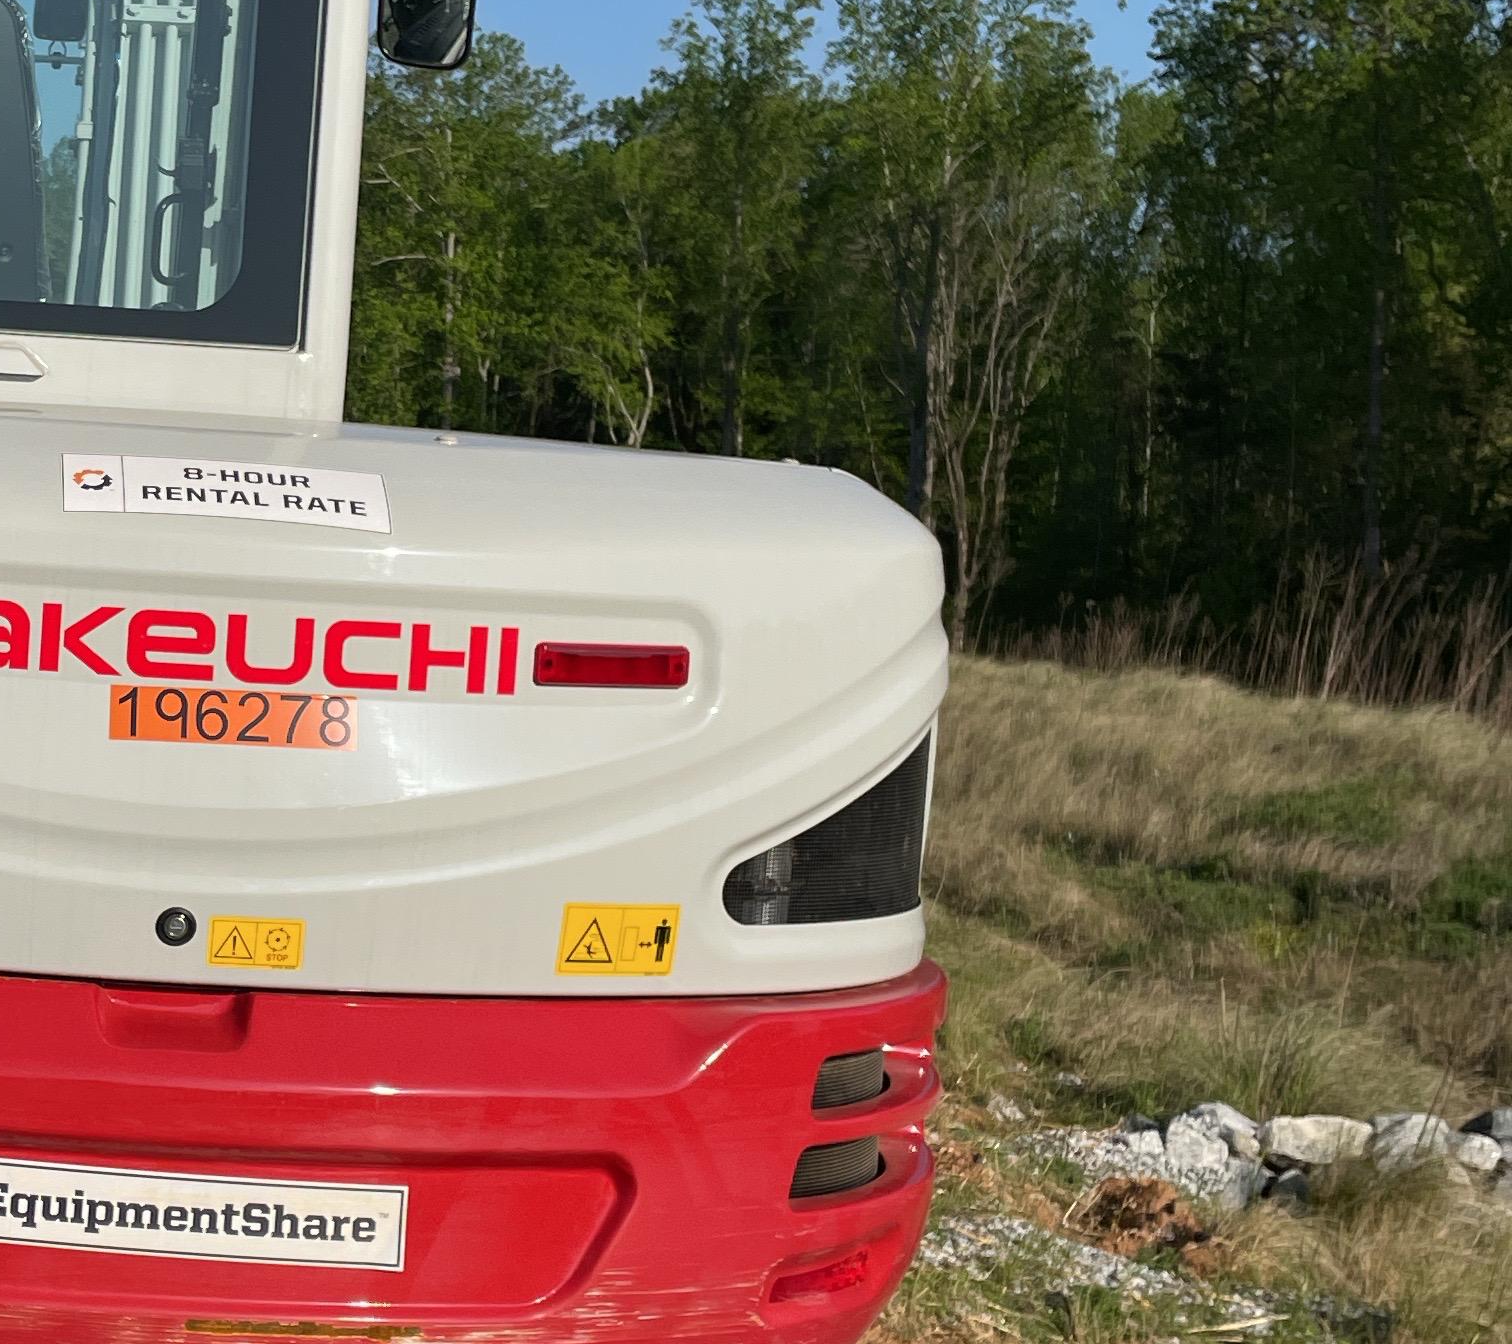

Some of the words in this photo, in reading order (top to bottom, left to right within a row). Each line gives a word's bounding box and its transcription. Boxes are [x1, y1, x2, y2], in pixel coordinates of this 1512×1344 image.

[183, 467, 311, 489] 8-HOUR
[141, 485, 270, 507] RENTAL
[282, 493, 368, 517] RATE
[116, 686, 353, 748] 196278
[266, 953, 289, 962] STOP
